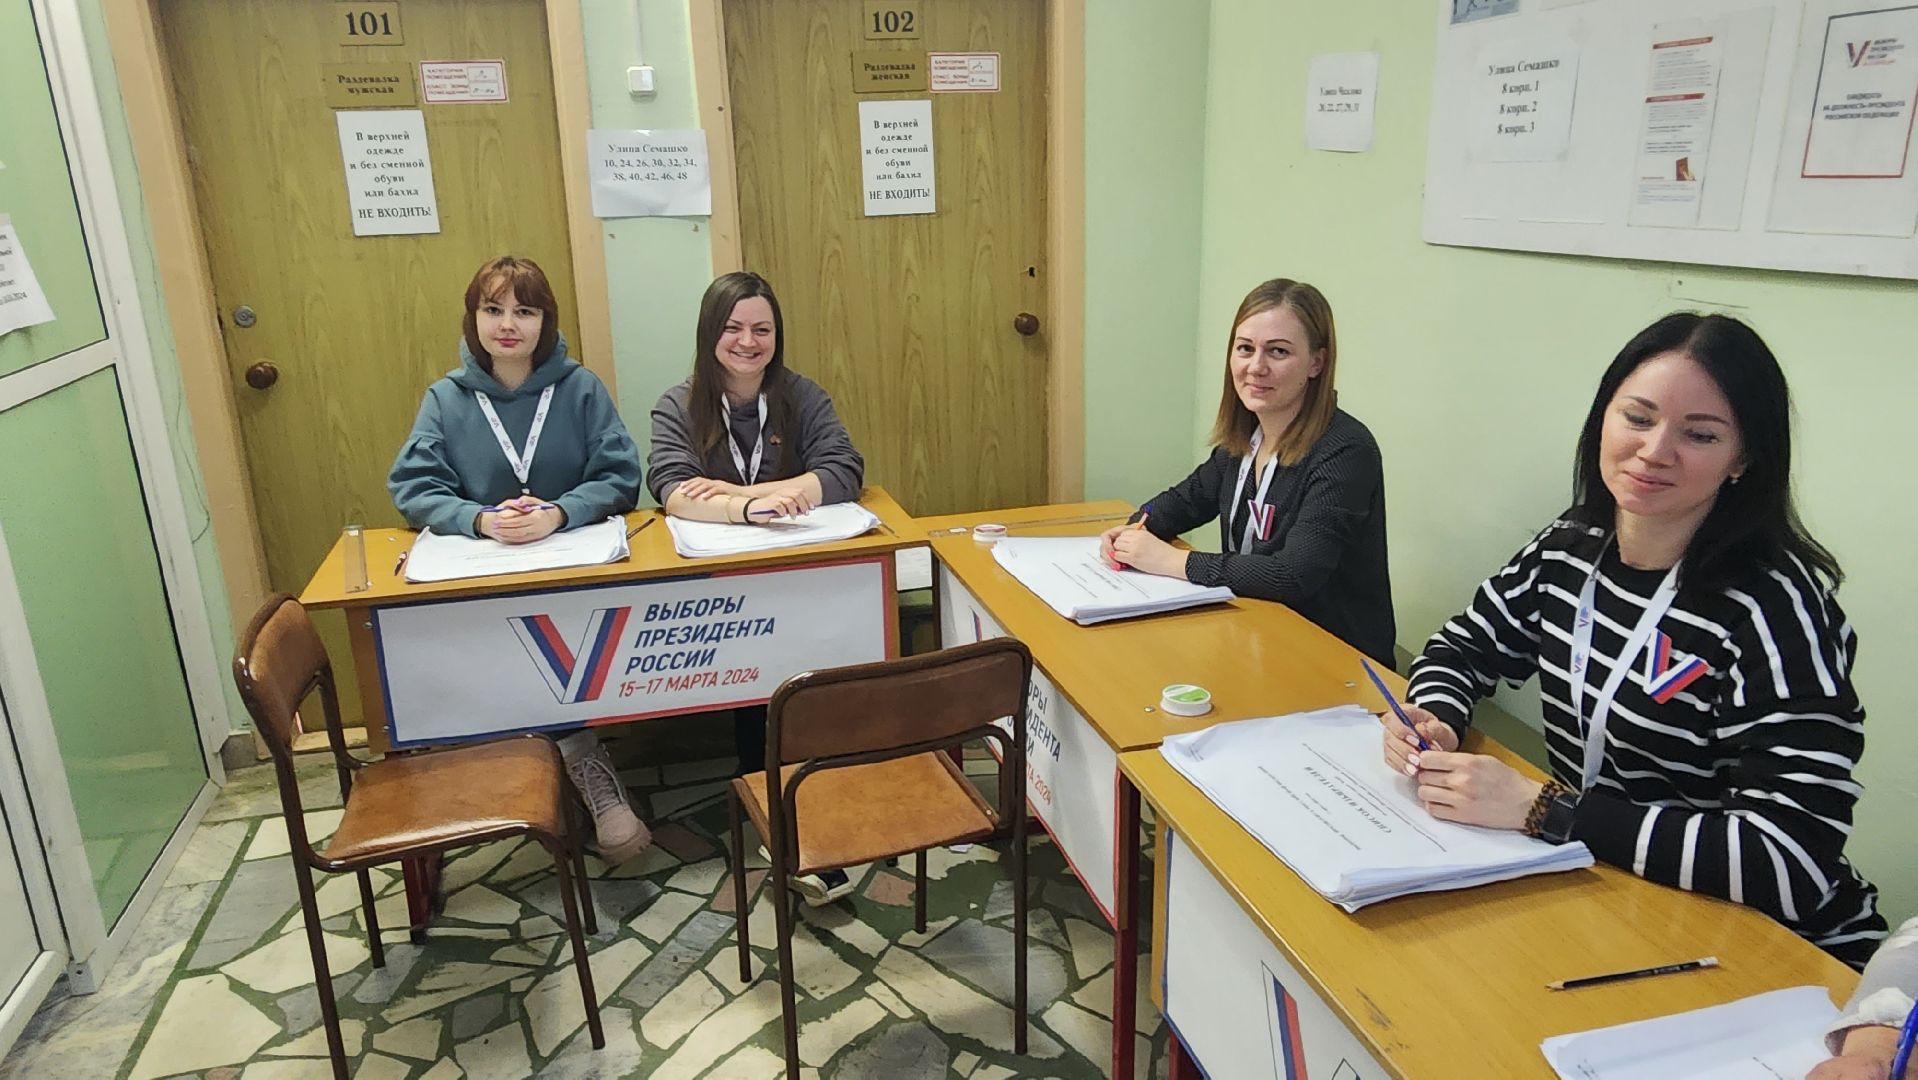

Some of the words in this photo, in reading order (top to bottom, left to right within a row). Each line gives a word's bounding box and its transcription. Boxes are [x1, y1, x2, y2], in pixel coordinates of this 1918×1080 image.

[345, 11, 392, 36] 101
[872, 10, 914, 33] 102
[864, 62, 916, 72] Раздевалка
[1488, 64, 1516, 76] Улица
[1517, 59, 1560, 72] Семашко
[336, 74, 400, 85] Раздевалка
[871, 73, 911, 81] женская
[347, 86, 395, 96] мужская
[1501, 82, 1507, 94] 8
[1499, 103, 1505, 114] 8
[1532, 100, 1538, 112] 2
[874, 120, 880, 129] В
[883, 118, 919, 130] верхней
[1529, 121, 1535, 133] 3
[356, 132, 364, 141] В
[367, 130, 410, 143] верхней
[881, 134, 913, 142] одежде
[366, 147, 404, 156] одежде
[608, 144, 640, 154] Улица
[643, 143, 689, 153] Семашко
[875, 146, 889, 155] без
[892, 144, 929, 154] сменной
[360, 160, 377, 170] без
[381, 159, 425, 170] сменной
[604, 159, 618, 169] 10,
[620, 159, 634, 169] 24,
[652, 158, 666, 168] 30,
[885, 159, 911, 169] обуви
[374, 174, 405, 185] обуви
[629, 172, 643, 181] 40,
[645, 172, 659, 181] 42,
[677, 172, 688, 180] 48
[896, 171, 922, 180] бахил
[364, 189, 384, 198] или
[388, 187, 419, 197] бахил
[869, 190, 883, 200] НЕ
[885, 188, 931, 200] ВХОДИТЬ!
[359, 208, 374, 219] НЕ
[377, 206, 432, 219] ВХОДИТЬ!
[644, 595, 746, 623] ВЫБОРЫ
[634, 617, 776, 649] ПРЕЗИДЕНТА
[625, 648, 717, 676] РОССИИ
[664, 671, 719, 693] МАРТА
[721, 667, 760, 686] 2024
[1026, 705, 1062, 762] ИДЕНТА
